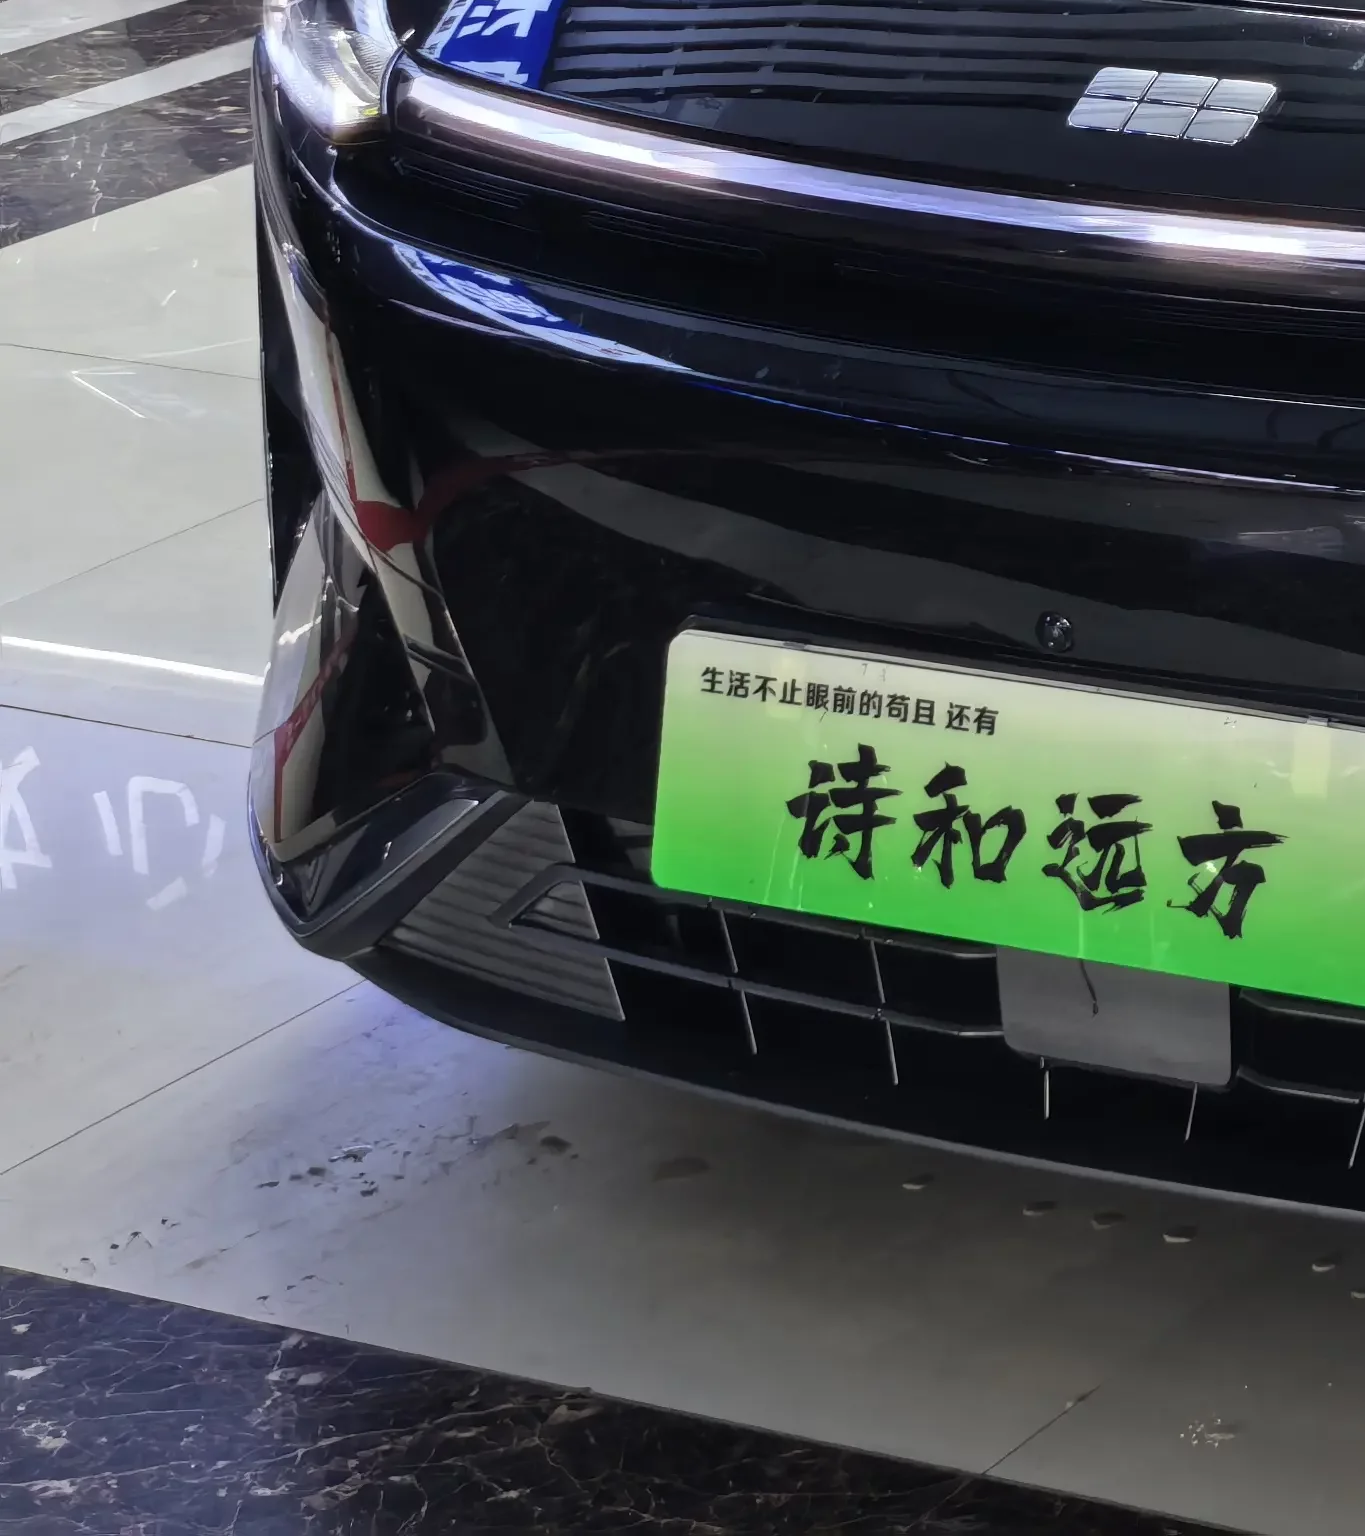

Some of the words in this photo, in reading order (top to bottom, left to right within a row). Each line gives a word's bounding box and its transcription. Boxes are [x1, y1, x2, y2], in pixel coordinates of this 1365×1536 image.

[700, 665, 938, 727] 生活不止眼前的苟且
[944, 700, 1001, 737] 还有
[785, 742, 1291, 940] 诗和远方
